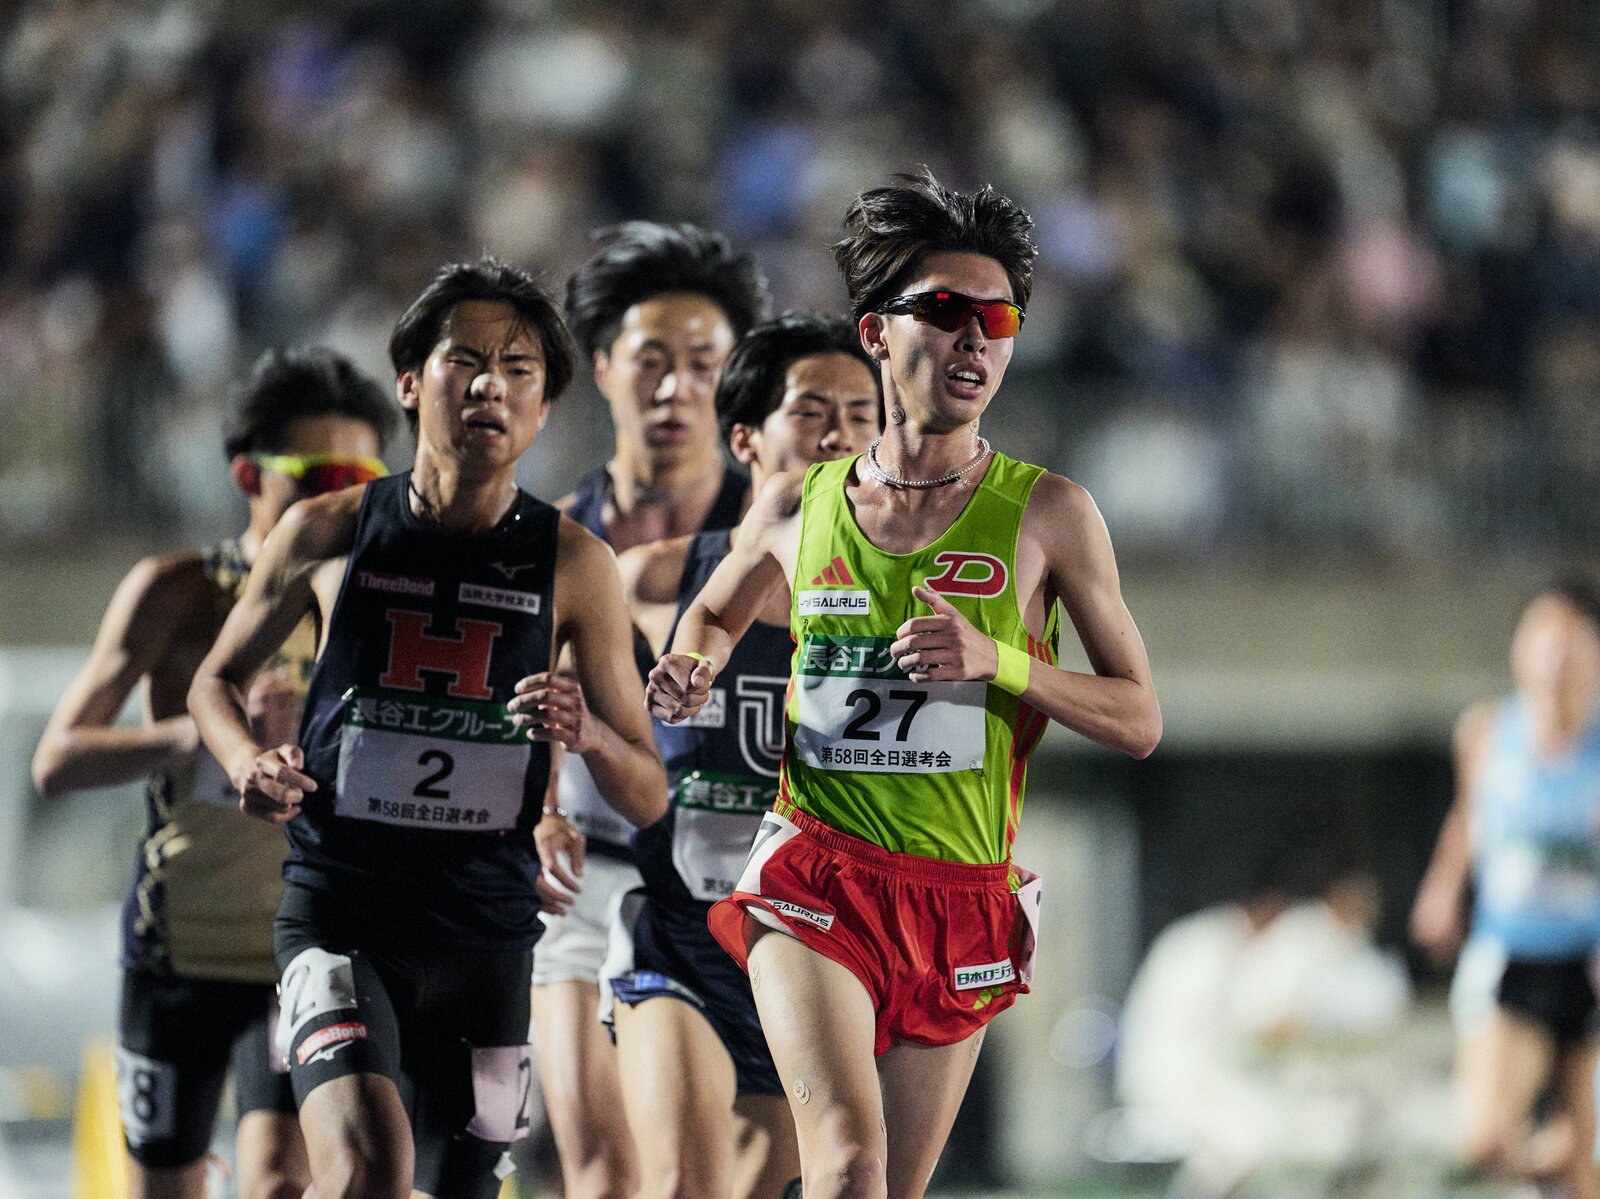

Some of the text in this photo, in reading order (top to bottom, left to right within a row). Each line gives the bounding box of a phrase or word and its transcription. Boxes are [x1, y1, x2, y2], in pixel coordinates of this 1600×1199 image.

[924, 551, 1008, 598] D
[812, 597, 867, 608] SAURUS
[379, 608, 502, 699] H
[842, 689, 928, 742] 27
[413, 750, 454, 799] 2
[821, 746, 952, 768] 第58回全日選考会
[773, 901, 829, 927] SAURUS
